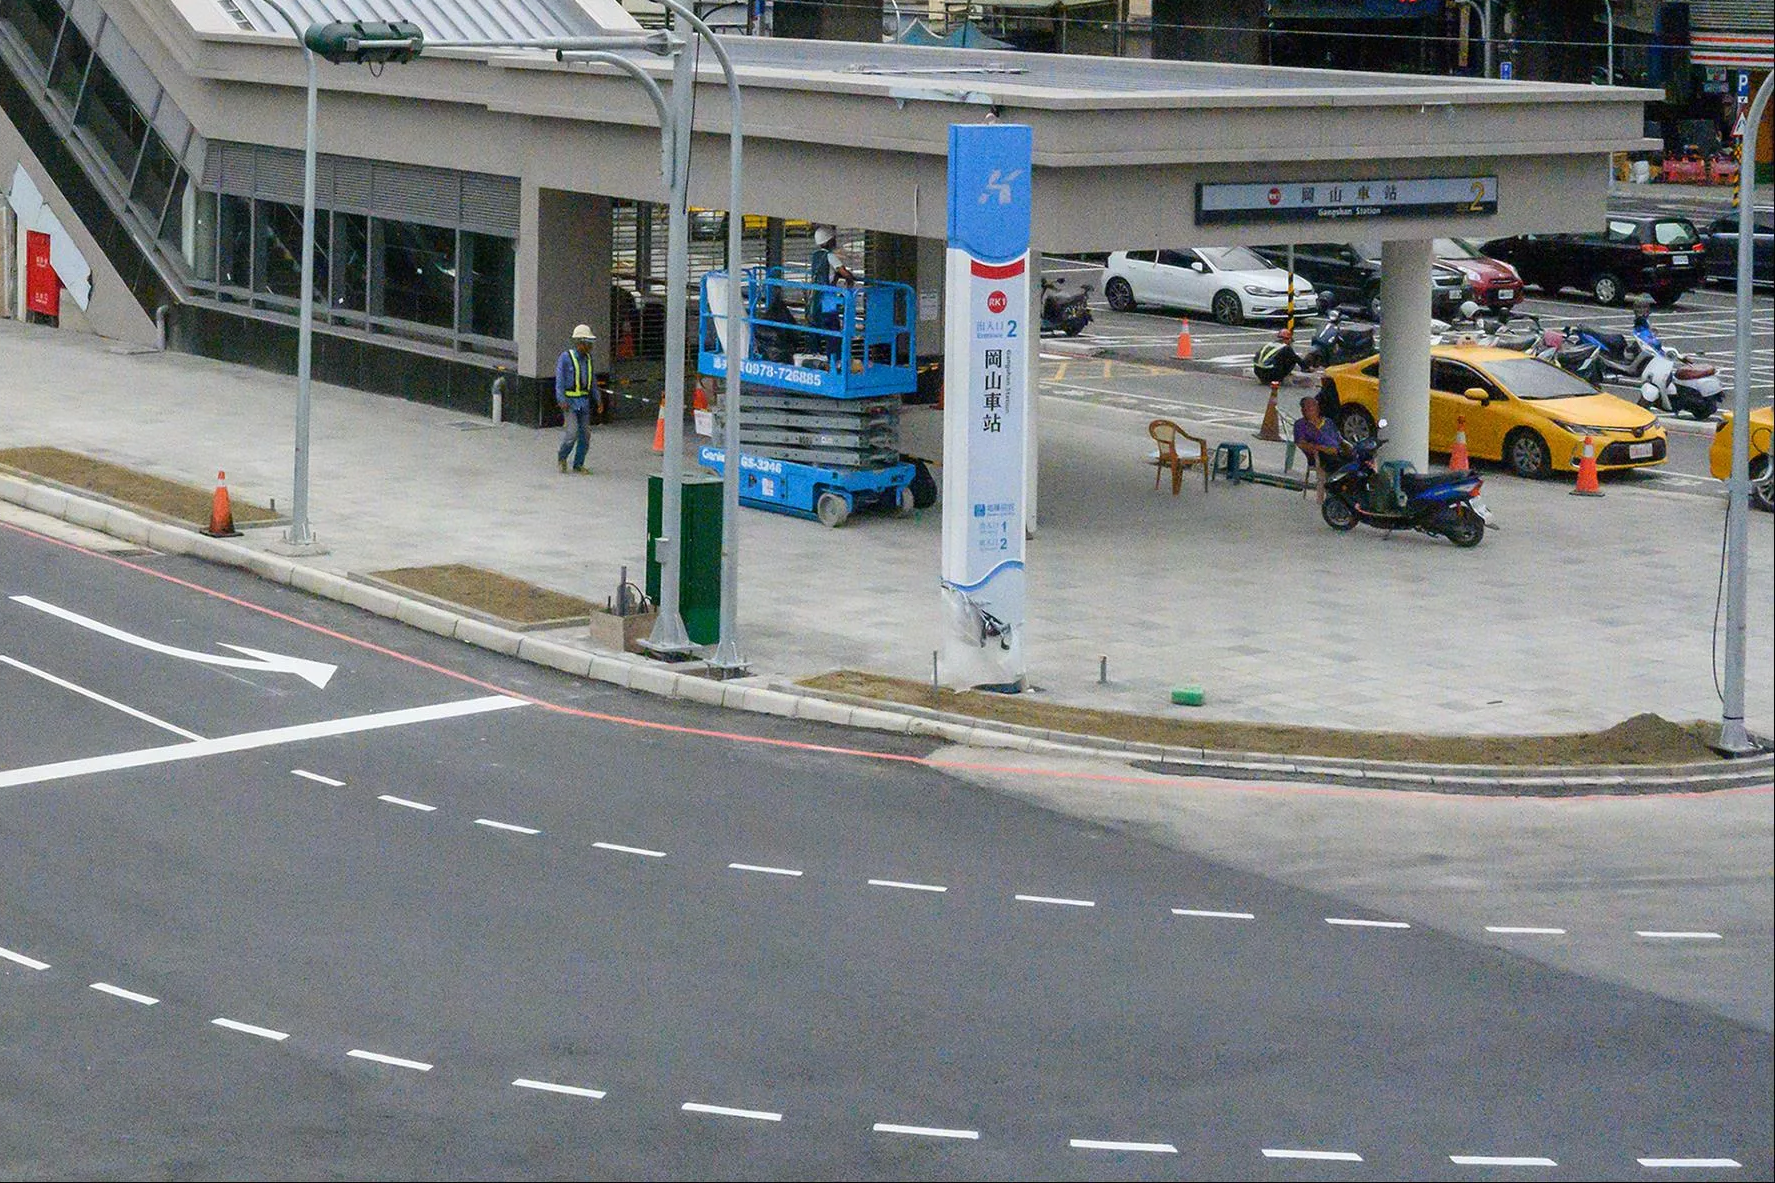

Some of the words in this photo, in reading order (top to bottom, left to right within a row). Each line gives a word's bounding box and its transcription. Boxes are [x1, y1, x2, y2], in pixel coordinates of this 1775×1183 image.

[1301, 183, 1397, 204] 岡山車站
[1469, 181, 1485, 211] 2
[1356, 206, 1381, 215] Station
[1007, 319, 1018, 338] 2
[744, 362, 822, 387] 0978-726885
[983, 349, 1002, 433] 岡山車站
